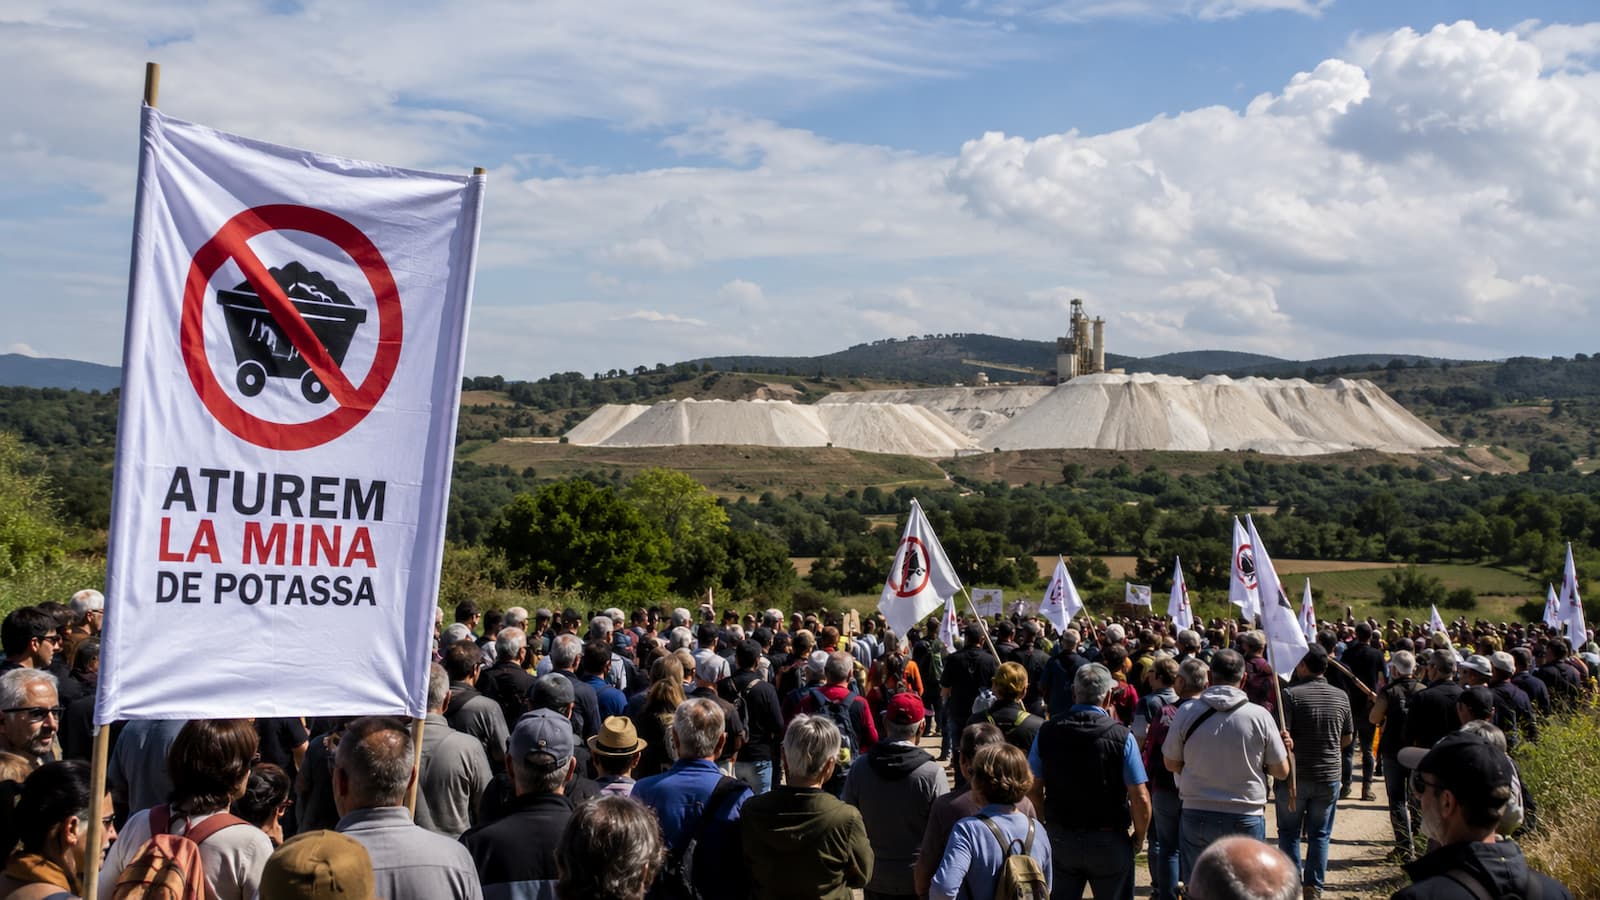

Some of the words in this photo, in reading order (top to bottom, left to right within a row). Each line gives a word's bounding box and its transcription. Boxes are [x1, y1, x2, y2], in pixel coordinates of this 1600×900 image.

[162, 466, 386, 521] ATUREM
[158, 517, 222, 563] LA
[242, 521, 377, 568] MINA
[156, 571, 202, 603] DE
[214, 572, 377, 606] POTASSA
